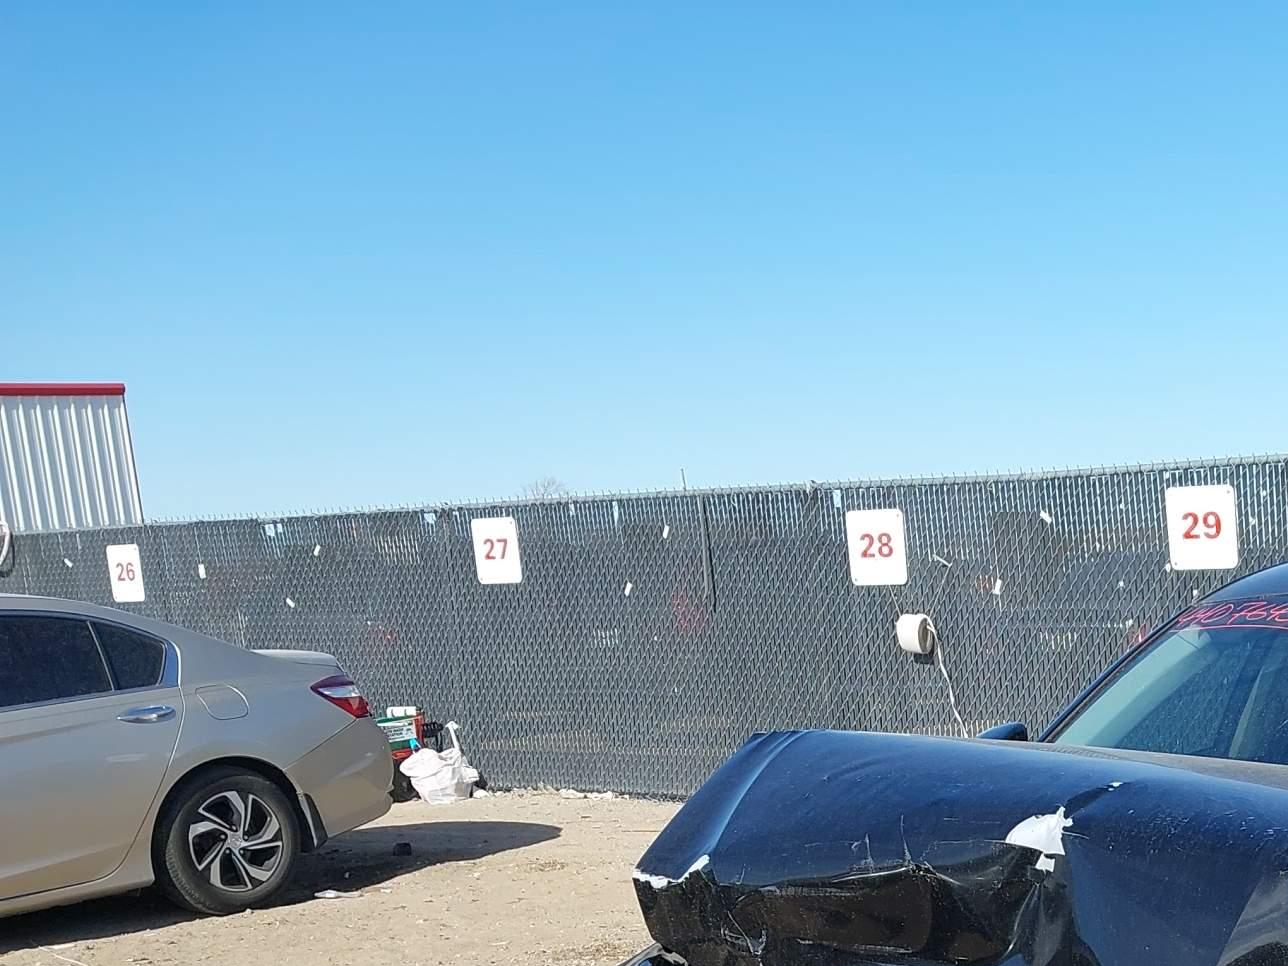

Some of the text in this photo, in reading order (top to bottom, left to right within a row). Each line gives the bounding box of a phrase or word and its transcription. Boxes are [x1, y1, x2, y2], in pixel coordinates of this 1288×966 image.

[1182, 511, 1222, 540] 29
[483, 538, 509, 562] 27
[860, 532, 894, 559] 28
[115, 561, 136, 582] 26
